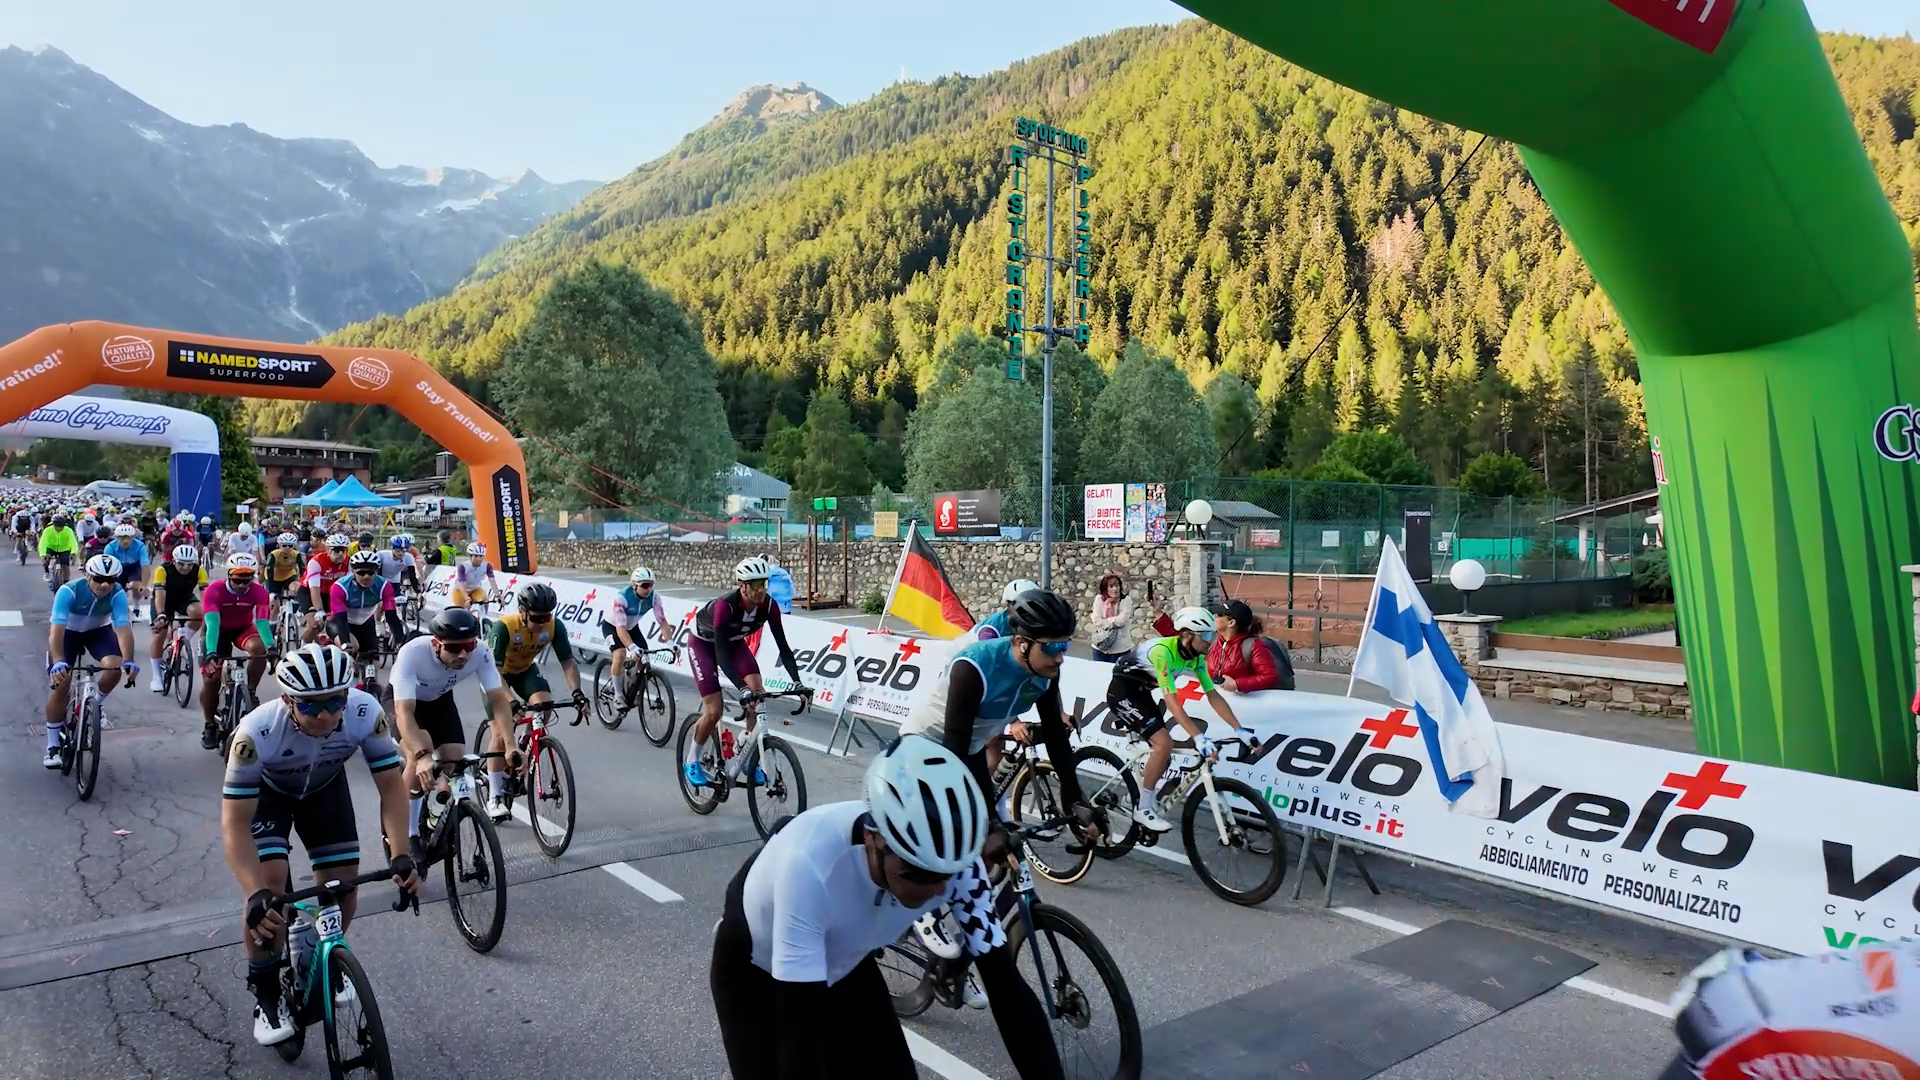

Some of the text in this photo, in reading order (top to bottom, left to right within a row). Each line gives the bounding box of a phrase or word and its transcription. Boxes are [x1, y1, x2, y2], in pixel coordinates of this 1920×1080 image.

[1016, 116, 1088, 155] SPORTING
[1006, 144, 1023, 380] RISTORANTE
[1075, 165, 1091, 345] PIZZERIA
[106, 343, 148, 357] NATURAL
[110, 350, 151, 363] QUALITY
[209, 368, 285, 381] SUPERFOOD
[353, 362, 387, 377] NATURAL
[353, 369, 386, 385] QUALITY
[68, 403, 171, 436] Components
[416, 380, 494, 443] Stay Trained!
[1086, 488, 1113, 499] GELATI
[514, 499, 524, 547] SUPERFOOD
[1087, 519, 1121, 529] FRESCHE
[1097, 508, 1121, 518] BIBITE
[555, 599, 593, 625] velo
[764, 676, 834, 703] velop.it
[854, 652, 920, 692] elo
[866, 698, 911, 717] PERSONALIZZATO
[1241, 728, 1423, 797] velo
[1233, 768, 1401, 814] CYCLING WEAR
[1232, 786, 1405, 839] loplus.it
[1499, 777, 1755, 870] velo
[1486, 826, 1730, 891] CYCLING WEAR
[1479, 844, 1742, 924] ABBIGLIAMENTO PERSONALIZZATO
